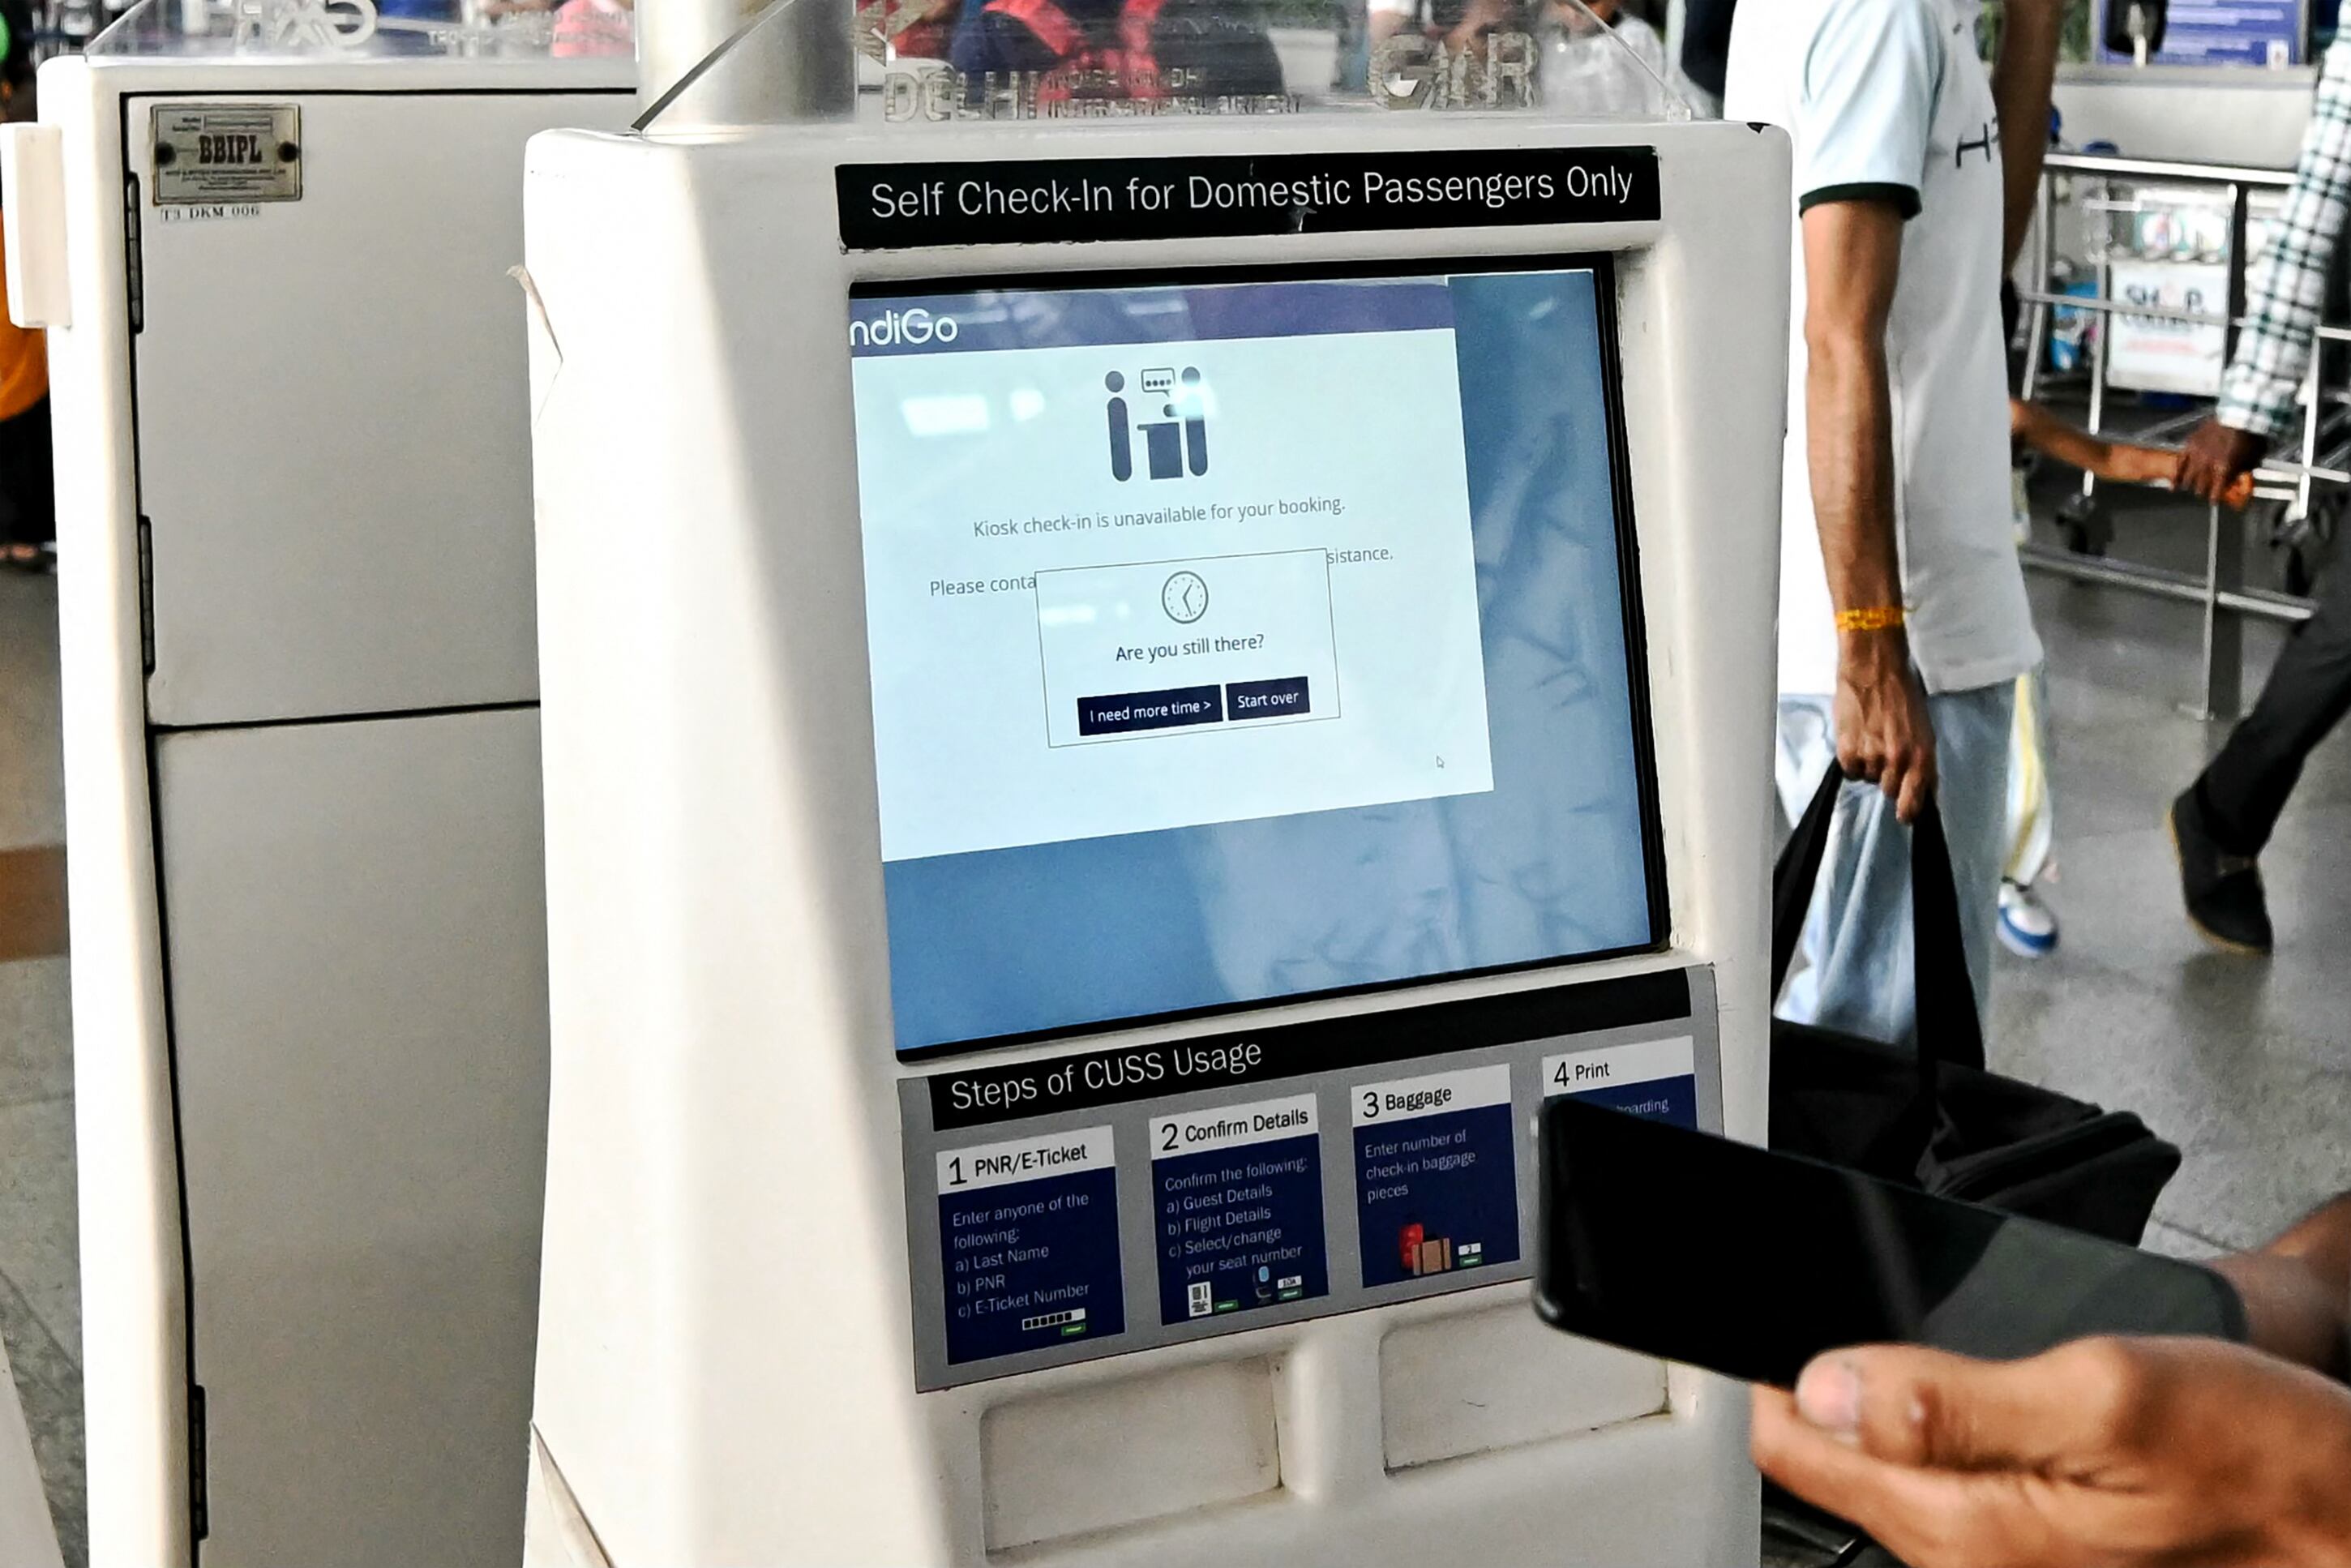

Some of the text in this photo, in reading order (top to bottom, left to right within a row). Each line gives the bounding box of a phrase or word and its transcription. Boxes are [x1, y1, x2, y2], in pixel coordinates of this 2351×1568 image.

[885, 71, 1038, 122] DELHI
[199, 135, 263, 164] BBIPL
[871, 165, 1633, 218] Self Check-In for Domestic Passengers Only
[190, 206, 224, 219] DKM
[849, 308, 959, 346] ndiGo
[974, 496, 1346, 538] Kiosk check-in is unavailable for your booking.
[930, 579, 985, 597] Please
[1116, 633, 1265, 664] Are you still there?
[1090, 709, 1094, 722] I
[1098, 706, 1130, 722] need
[1134, 705, 1169, 720] more
[1171, 701, 1201, 716] time
[1238, 692, 1299, 709] Start over
[951, 1043, 1263, 1110] Steps of CUSS Usage
[1553, 1060, 1610, 1087] 4 Print
[1363, 1087, 1453, 1118] 3 Baggage
[1161, 1108, 1309, 1151] 2 Confirm Details
[1365, 1129, 1467, 1159] Enter number of
[949, 1143, 1088, 1185] 1 PNR/E-Ticket
[1165, 1157, 1308, 1192] Confirm the following:
[1366, 1150, 1476, 1180] check-in baggage
[953, 1193, 1090, 1227] Enter anyone of the
[1167, 1184, 1273, 1215] a) Guest Details
[1368, 1184, 1409, 1205] pieces
[1167, 1206, 1271, 1236] b) Flight Details
[954, 1227, 1020, 1250] following:
[1168, 1227, 1282, 1258] c) Select/change
[955, 1245, 1050, 1273] a) Last Name
[1186, 1245, 1303, 1279] your seat number
[957, 1274, 1006, 1296] b) PNR
[958, 1283, 1090, 1319] c) E-Ticket Number
